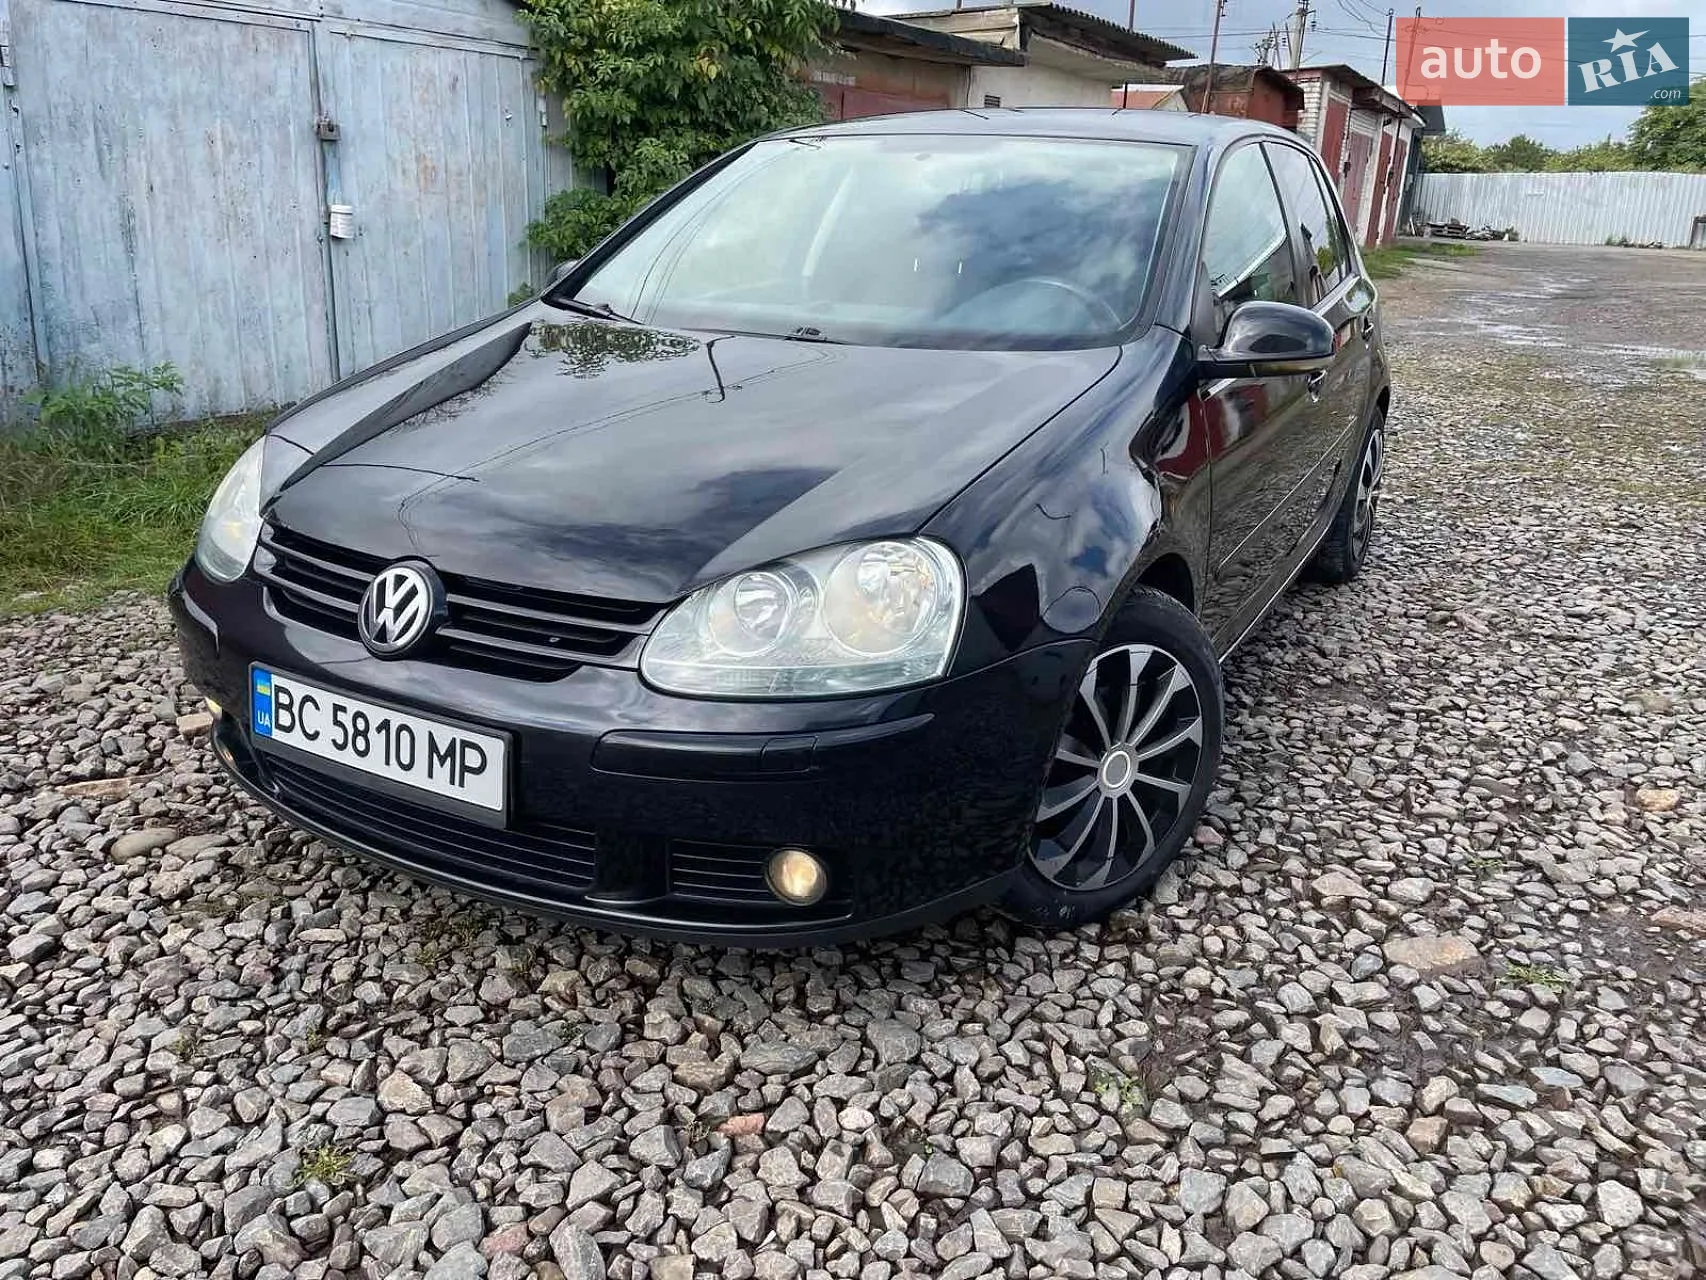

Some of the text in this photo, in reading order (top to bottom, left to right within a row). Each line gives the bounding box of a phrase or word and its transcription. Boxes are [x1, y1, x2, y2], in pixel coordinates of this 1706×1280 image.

[257, 710, 271, 728] UA
[274, 684, 487, 788] BC 5810 MP
